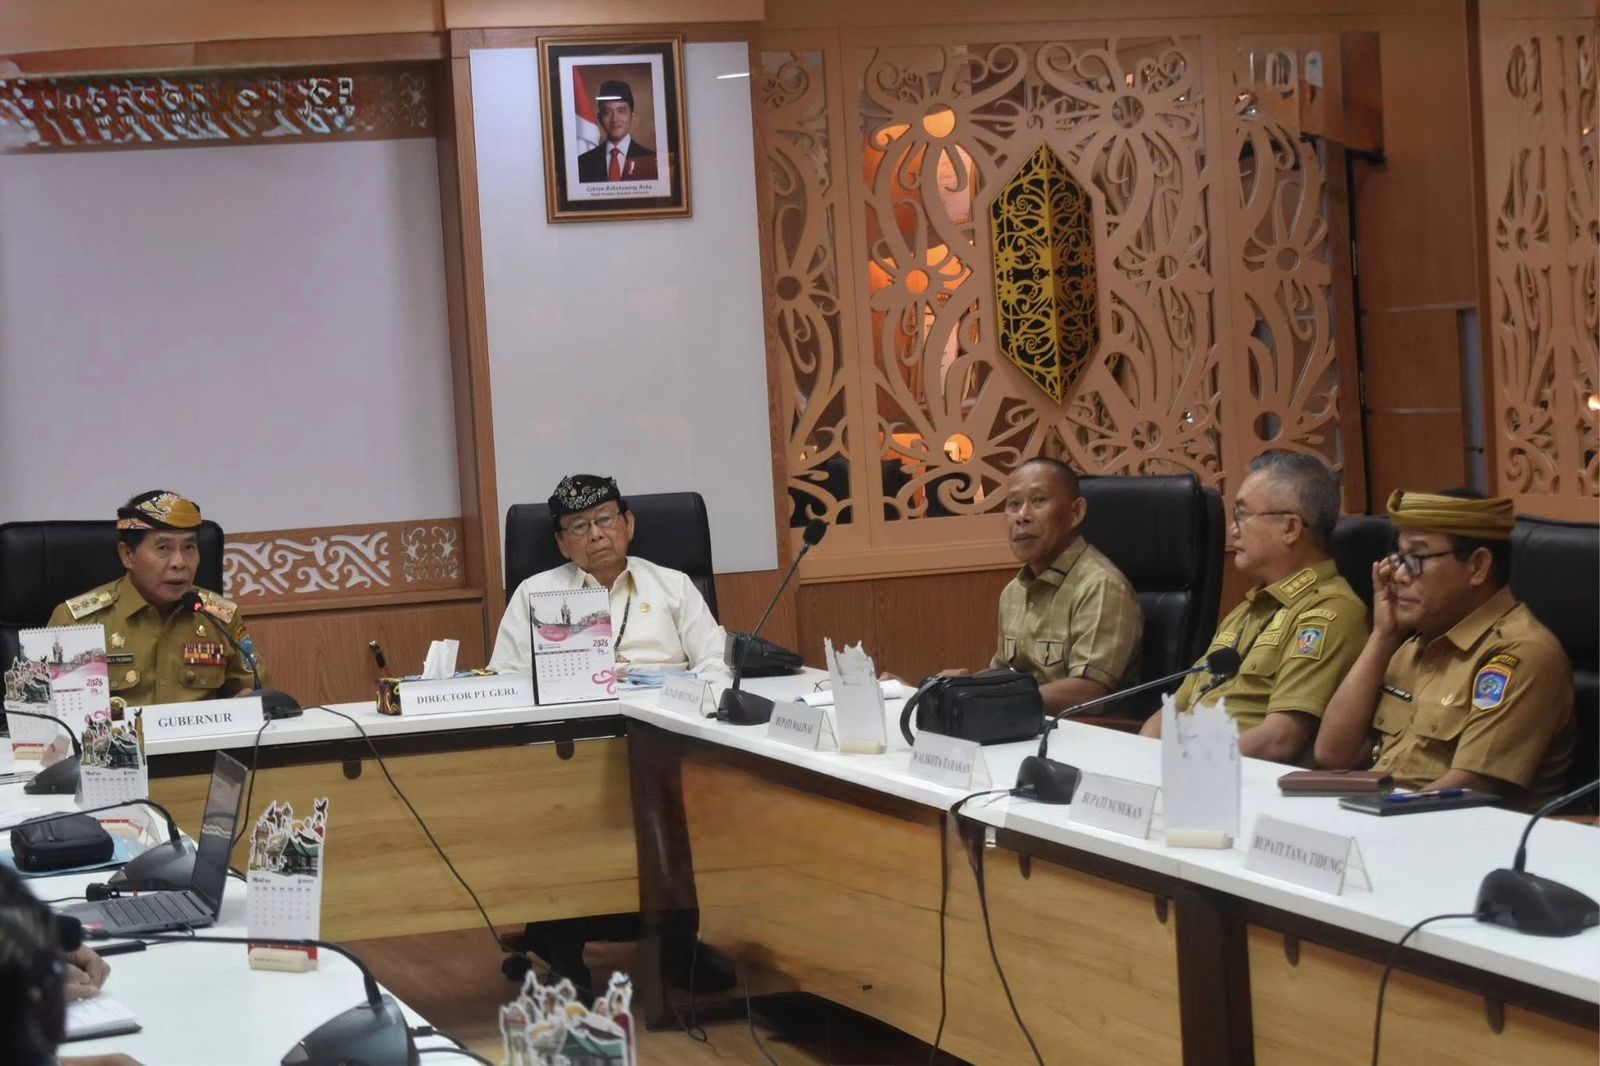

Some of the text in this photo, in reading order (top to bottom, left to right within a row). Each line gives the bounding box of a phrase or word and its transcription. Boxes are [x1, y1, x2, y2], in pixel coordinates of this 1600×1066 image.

[416, 692, 472, 704] DIRECTOR
[474, 689, 486, 699] PT
[158, 713, 232, 728] GUBERNUR
[1254, 835, 1345, 874] BUPATI TANA TIDUNG
